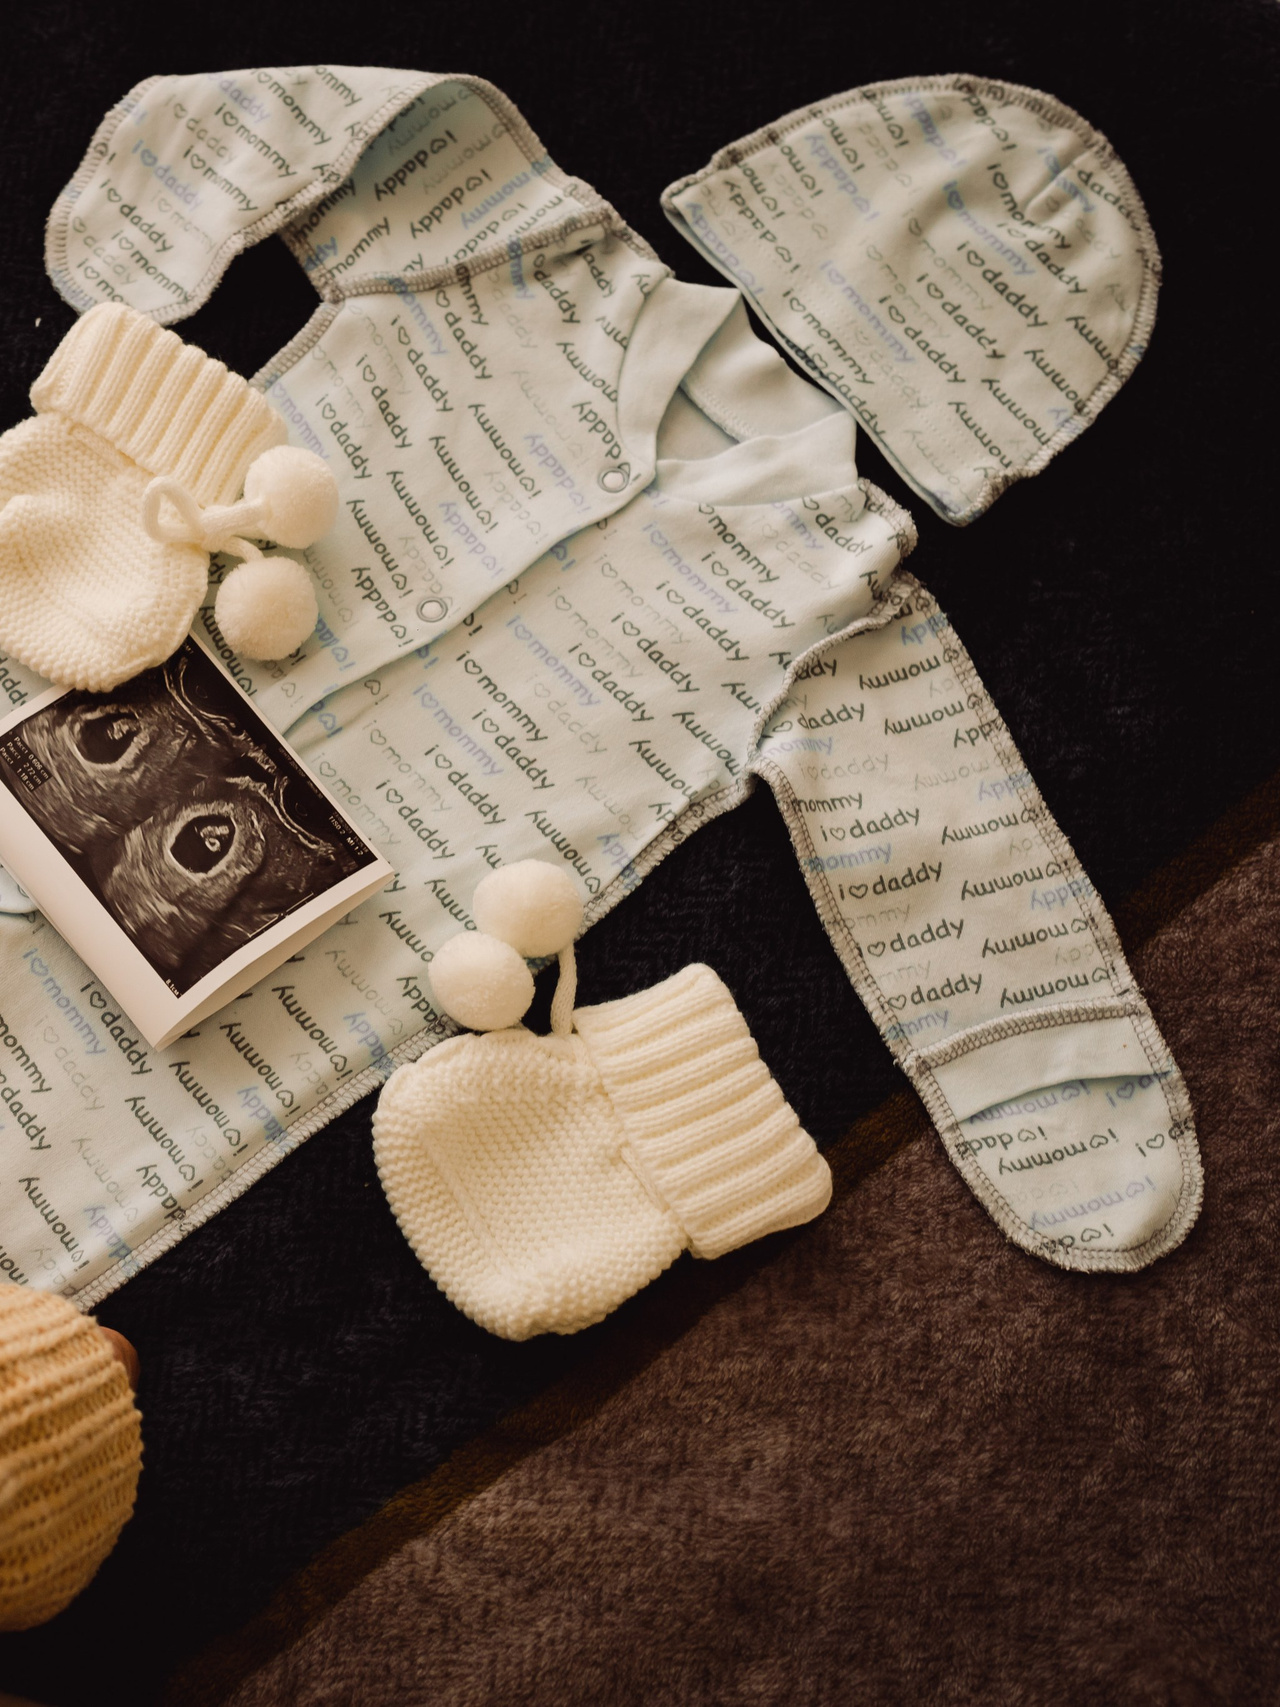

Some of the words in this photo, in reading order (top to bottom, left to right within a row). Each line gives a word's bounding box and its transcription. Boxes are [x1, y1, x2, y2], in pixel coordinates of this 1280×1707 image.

[268, 81, 332, 146] mommy
[235, 123, 297, 178] mommy
[374, 147, 432, 201] daddy
[805, 134, 859, 194] daddy
[120, 203, 173, 253] daddy
[410, 190, 464, 239] daddy
[461, 171, 531, 230] mommy
[724, 180, 777, 243] daddy
[326, 217, 390, 278] mommy
[962, 211, 1036, 276] mommy
[1024, 239, 1087, 296] daddy
[533, 270, 581, 324] daddy
[842, 286, 916, 363] mommy
[981, 267, 1048, 328] daddy
[444, 311, 493, 380] daddy
[803, 312, 875, 385] mommy
[904, 326, 966, 383] daddy
[941, 301, 1006, 359] daddy
[407, 348, 454, 413] daddy
[371, 385, 413, 449] daddy
[468, 403, 525, 478] mommy
[572, 401, 622, 460] daddy
[981, 378, 1051, 446] mommy
[330, 420, 372, 480] daddy
[428, 436, 482, 511] mommy
[524, 433, 575, 490] daddy
[346, 499, 399, 572] mommy
[386, 470, 439, 544] mommy
[439, 501, 486, 555] daddy
[815, 512, 873, 556] daddy
[707, 514, 780, 584] mommy
[351, 567, 397, 622] daddy
[662, 547, 738, 614] mommy
[725, 579, 796, 629] daddy
[682, 605, 750, 661] daddy
[528, 640, 600, 707] mommy
[637, 638, 700, 693] daddy
[859, 655, 941, 690] mommy
[477, 675, 549, 742] mommy
[591, 669, 654, 723] daddy
[798, 703, 865, 730] daddy
[884, 701, 965, 736] mommy
[433, 708, 504, 776] mommy
[495, 734, 555, 790] daddy
[629, 740, 699, 800] mommy
[672, 711, 742, 777] mommy
[447, 770, 506, 825] daddy
[849, 808, 920, 839] daddy
[398, 805, 455, 860] daddy
[525, 810, 591, 877] mommy
[941, 813, 1019, 845] mommy
[872, 862, 942, 895] daddy
[961, 867, 1044, 901] mommy
[890, 919, 964, 953] daddy
[982, 922, 1069, 958] mommy
[43, 977, 107, 1056] mommy
[910, 973, 983, 1006] daddy
[1001, 975, 1089, 1008] mommy
[101, 1011, 152, 1076] daddy
[272, 985, 338, 1055] mommy
[220, 1022, 282, 1091] mommy
[1, 1087, 51, 1150] daddy
[169, 1061, 230, 1129] mommy
[125, 1096, 185, 1166] mommy
[998, 1142, 1087, 1175] mommy
[19, 1177, 79, 1253] mommy
[1029, 1191, 1122, 1229] mommy
